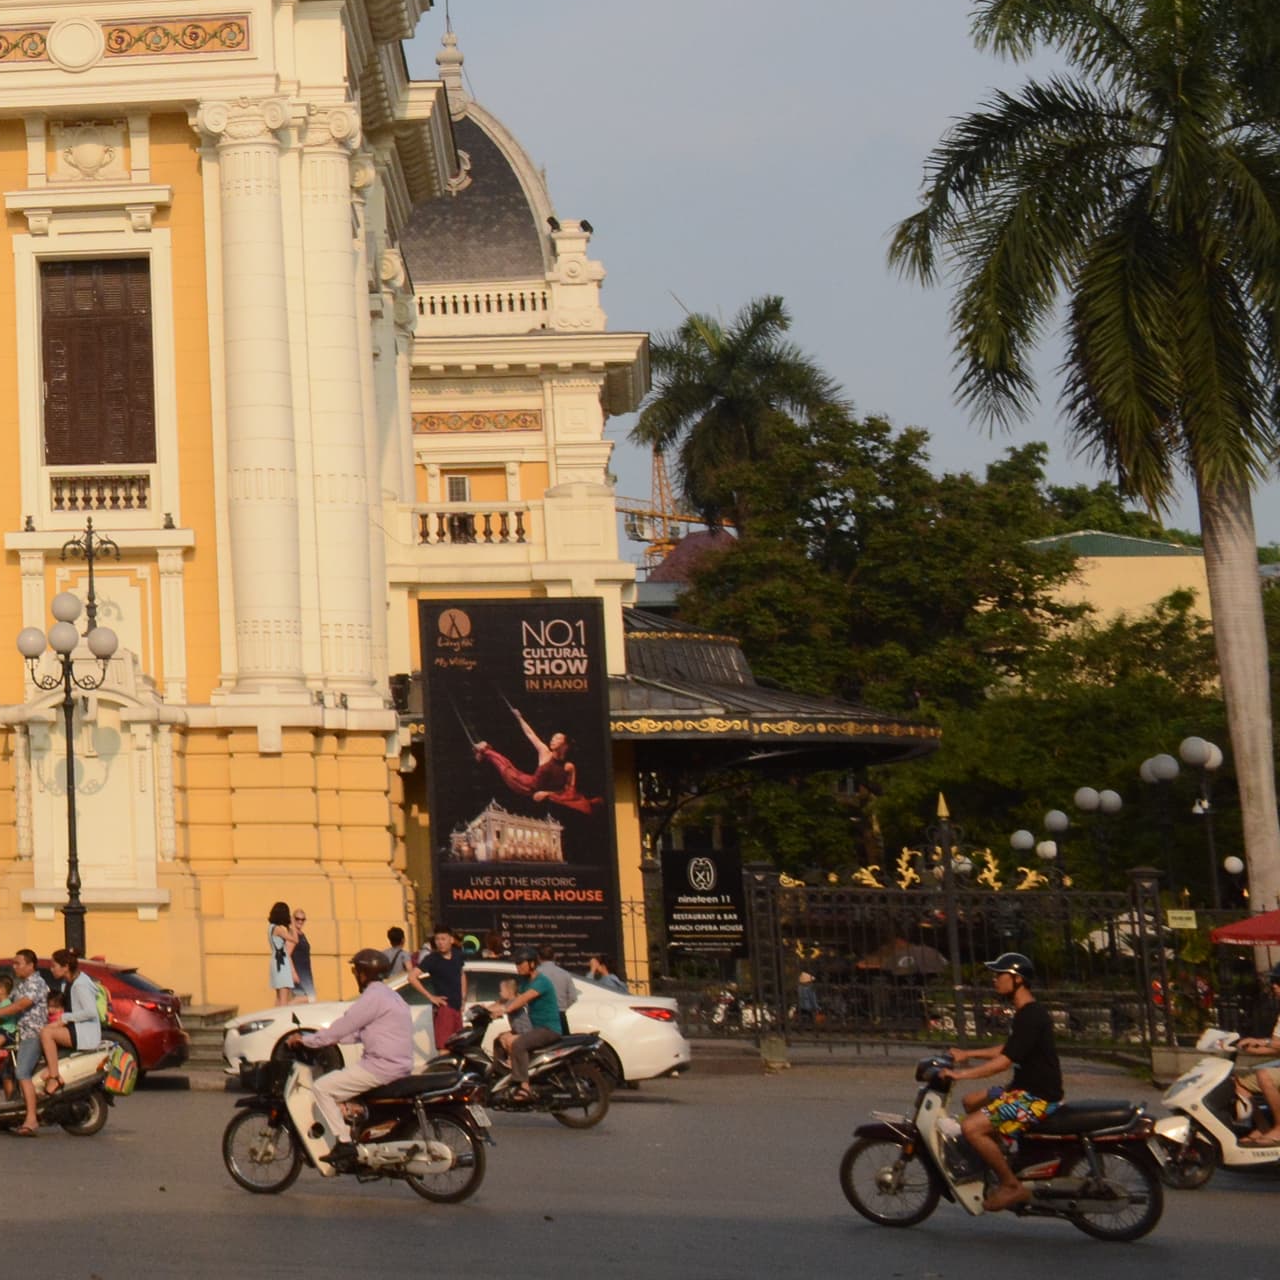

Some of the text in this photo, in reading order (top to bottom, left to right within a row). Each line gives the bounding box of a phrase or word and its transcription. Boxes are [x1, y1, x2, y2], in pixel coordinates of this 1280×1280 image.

[521, 619, 586, 647] NO.1
[522, 647, 588, 658] CULTURAL
[523, 659, 588, 675] SHOW
[525, 679, 588, 690] IN HANOI
[470, 876, 577, 887] LIVE AT THE HISTORIC
[452, 888, 603, 902] HANOI OPERA HOUSE
[678, 894, 719, 903] nineteen
